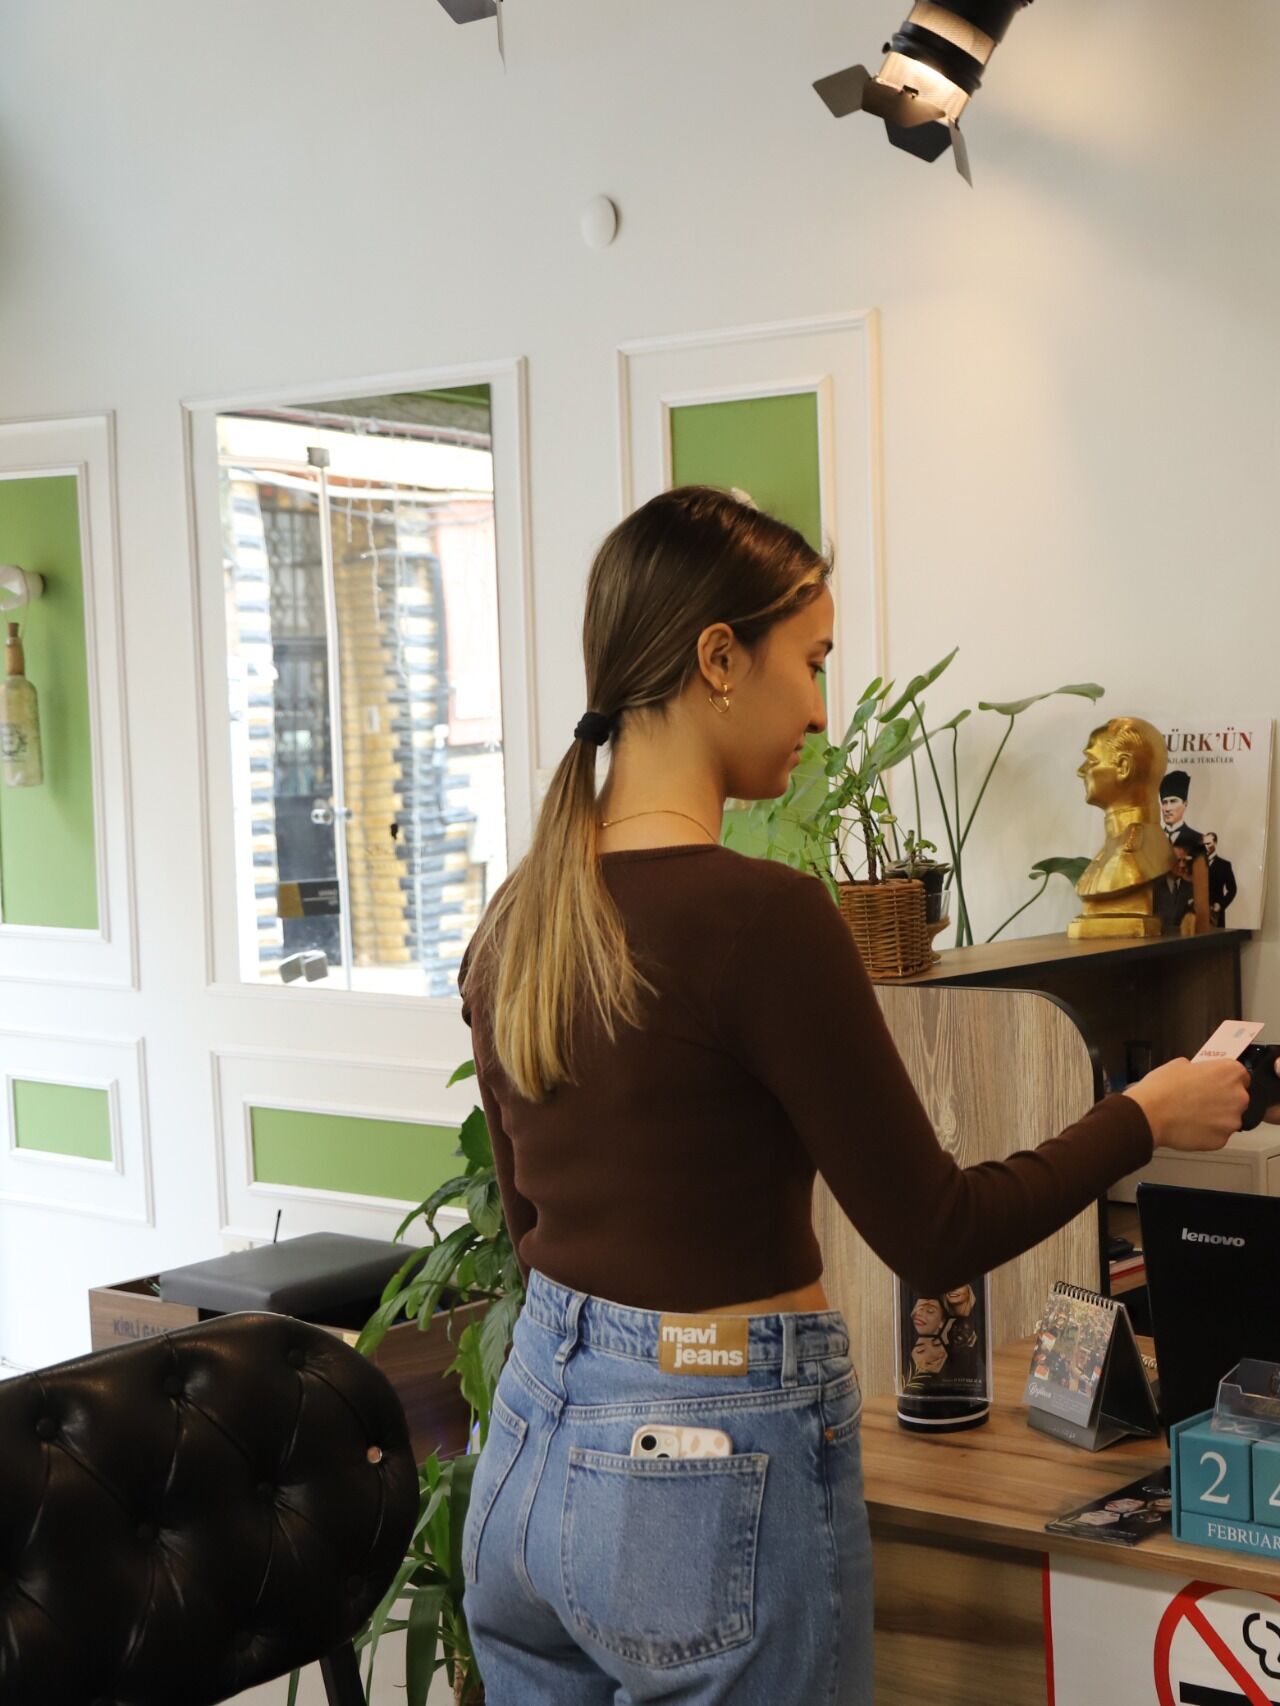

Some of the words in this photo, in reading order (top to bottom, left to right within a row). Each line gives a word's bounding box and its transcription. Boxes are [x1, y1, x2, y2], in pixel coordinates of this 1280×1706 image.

[1163, 727, 1253, 752] ÜRK'ÜN
[1181, 1227, 1245, 1247] lenovo
[662, 1323, 717, 1344] mavi
[674, 1343, 743, 1368] jeans
[1200, 1451, 1230, 1504] 2
